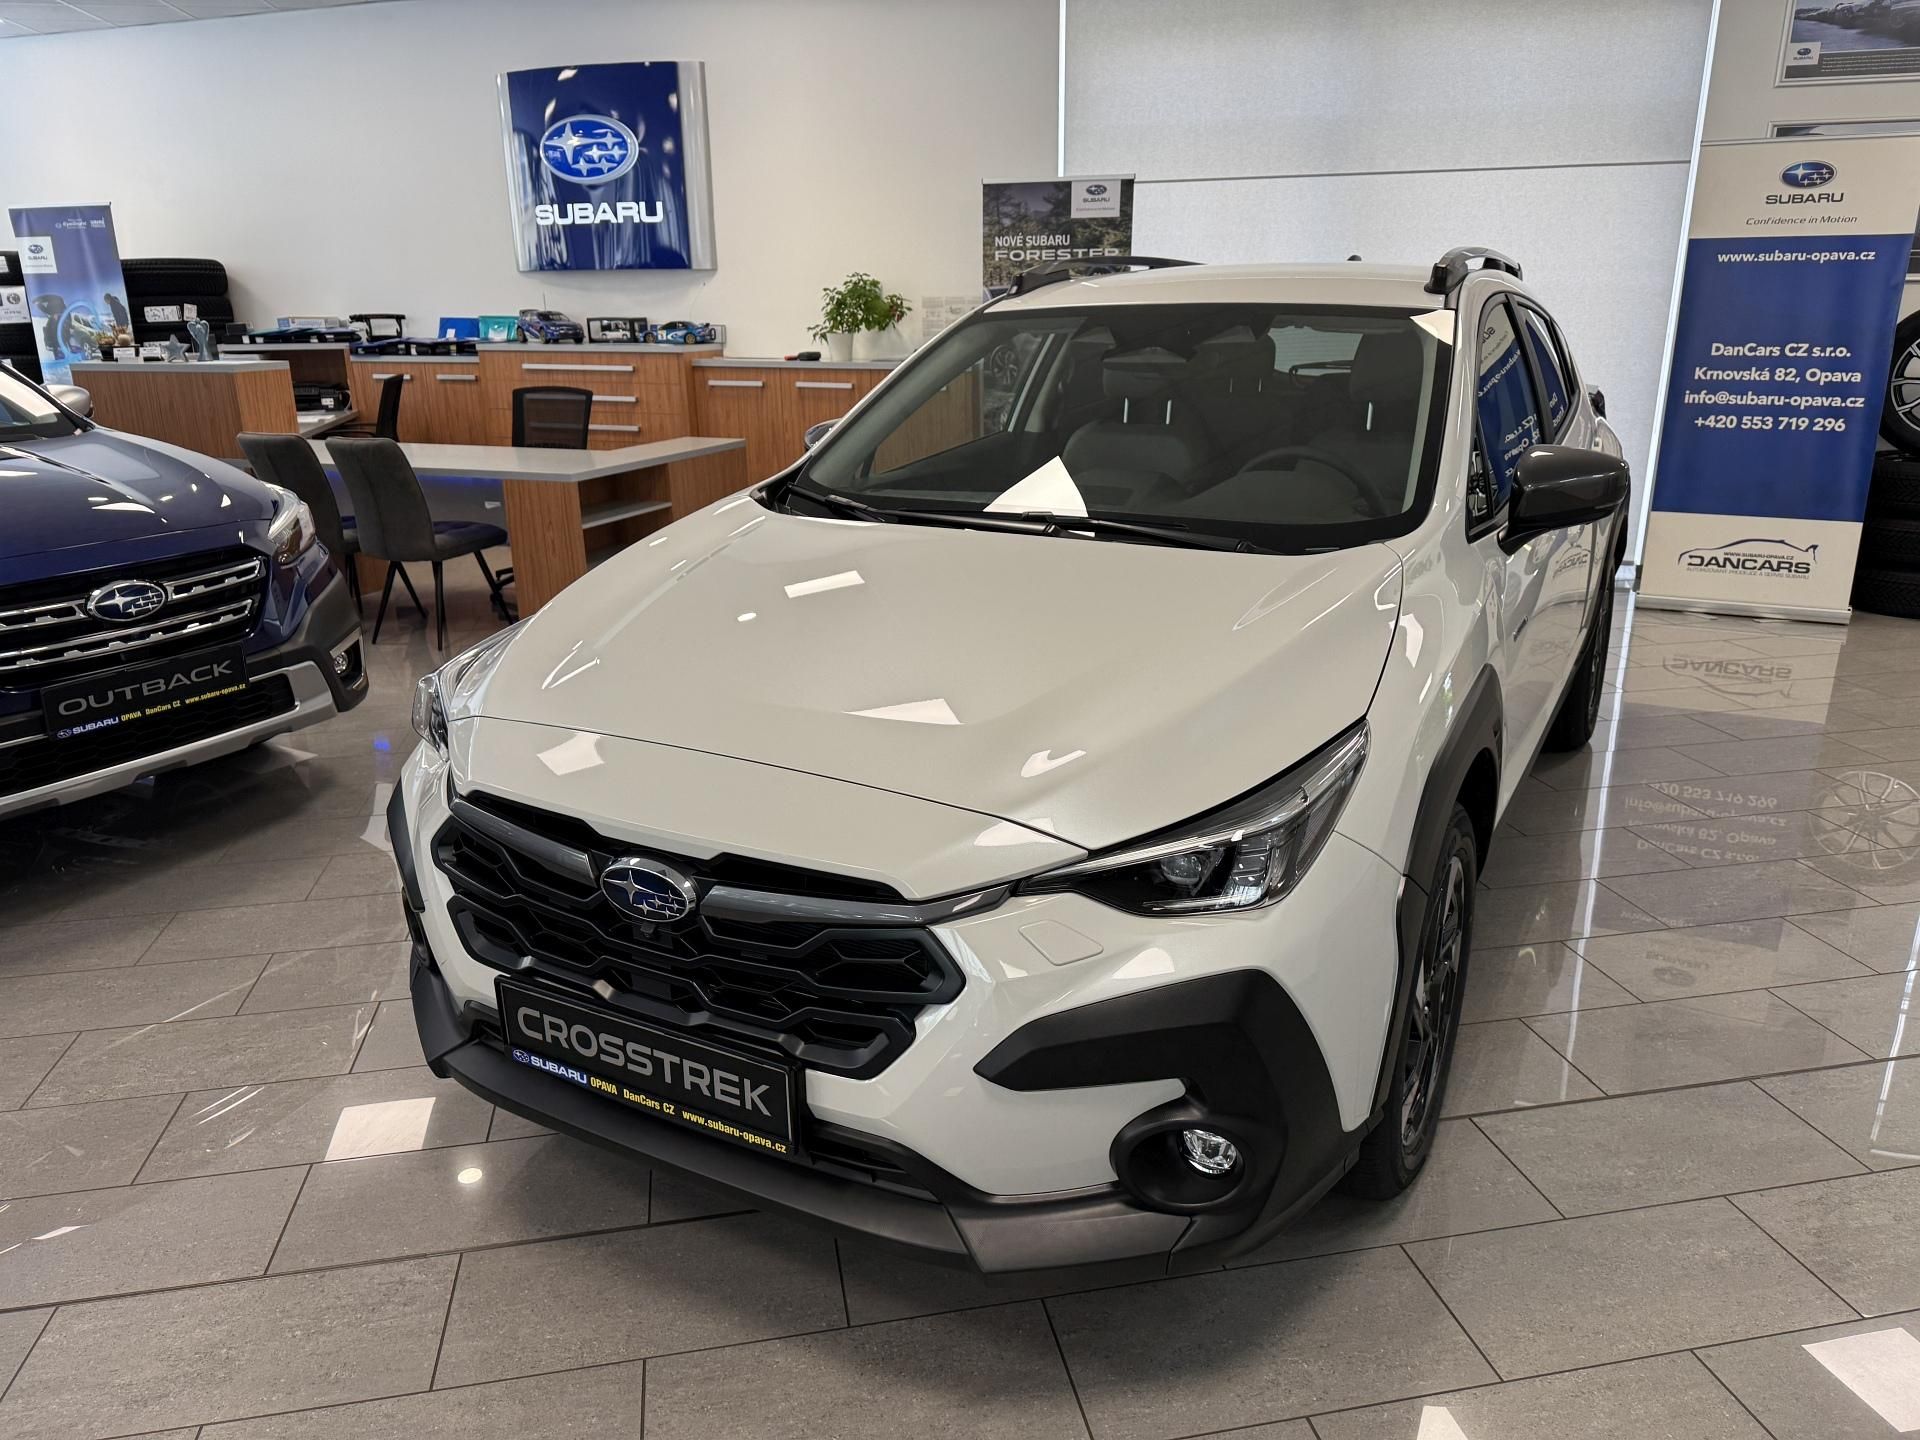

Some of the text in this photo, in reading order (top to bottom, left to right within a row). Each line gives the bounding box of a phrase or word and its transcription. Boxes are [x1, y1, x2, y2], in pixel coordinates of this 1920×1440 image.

[1765, 193, 1844, 205] SUBARU
[535, 201, 664, 226] SUBARU
[1745, 215, 1858, 226] Confidence in Motion
[994, 232, 1070, 247] NOVÉ SUBARU
[1717, 250, 1876, 264] www.subaru-opava.cz
[1711, 343, 1851, 358] DanCars CZ s.r.o.
[1694, 366, 1862, 386] Krnovská 82, Opava
[1684, 390, 1865, 410] info@subaru-opava.cz
[1694, 415, 1846, 432] +420 553 719 296
[1687, 555, 1811, 574] DANCARS
[58, 659, 233, 716] OUTBACK
[72, 683, 246, 735] SUBARU OPAVA DanCars CZ www.subaru-opava.cz
[517, 1006, 772, 1117] CROSSTREK
[530, 1055, 787, 1154] SUBARU OPAVA DanCars CZ www.subaru-opava.cz
